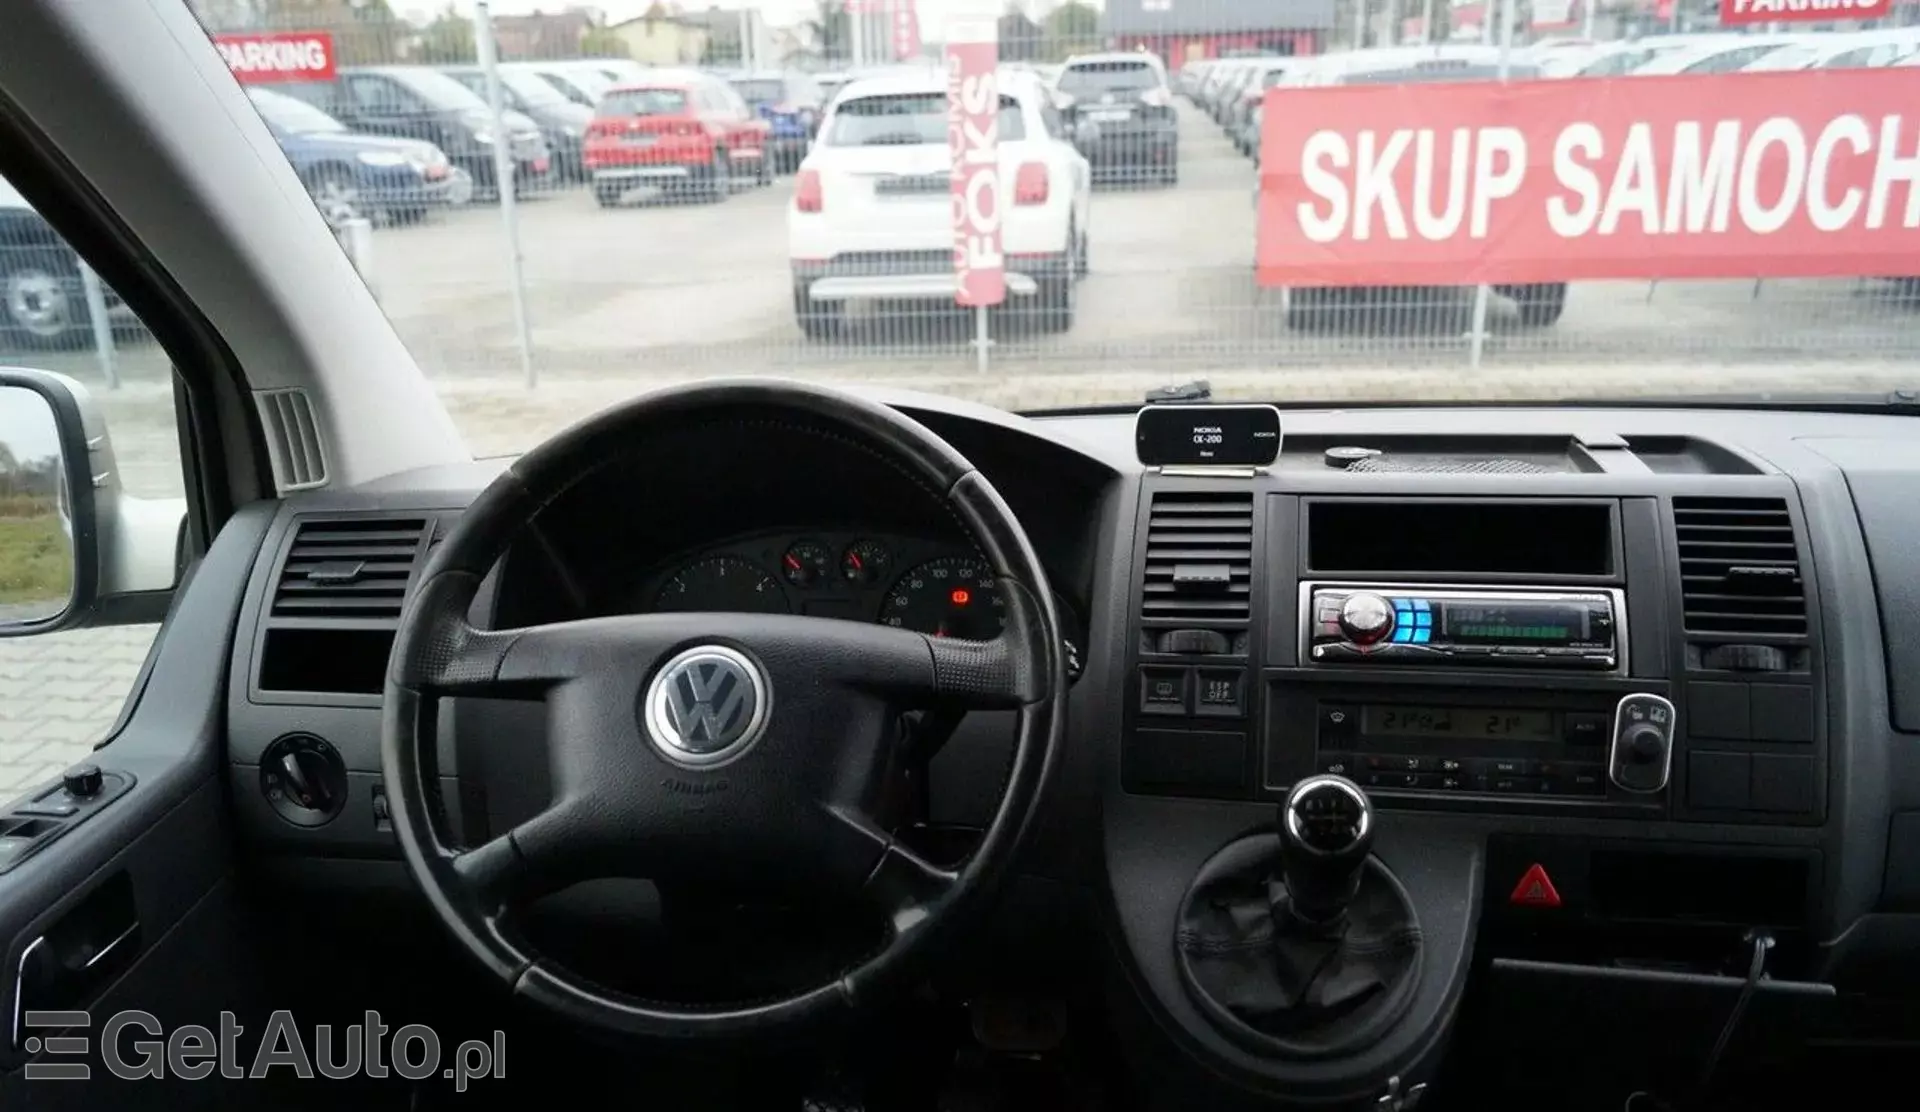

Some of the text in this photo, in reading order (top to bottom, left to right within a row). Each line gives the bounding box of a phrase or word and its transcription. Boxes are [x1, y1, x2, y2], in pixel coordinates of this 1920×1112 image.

[962, 72, 1002, 270] FOKS
[1297, 114, 1920, 242] SKUP SAMOCH
[1193, 435, 1222, 443] CK-200
[932, 568, 948, 578] 100
[959, 568, 973, 578] 120
[910, 579, 923, 589] 80
[979, 579, 994, 588] 140
[896, 597, 908, 606] 60
[1210, 681, 1229, 690] ESP
[1208, 691, 1228, 699] OFF
